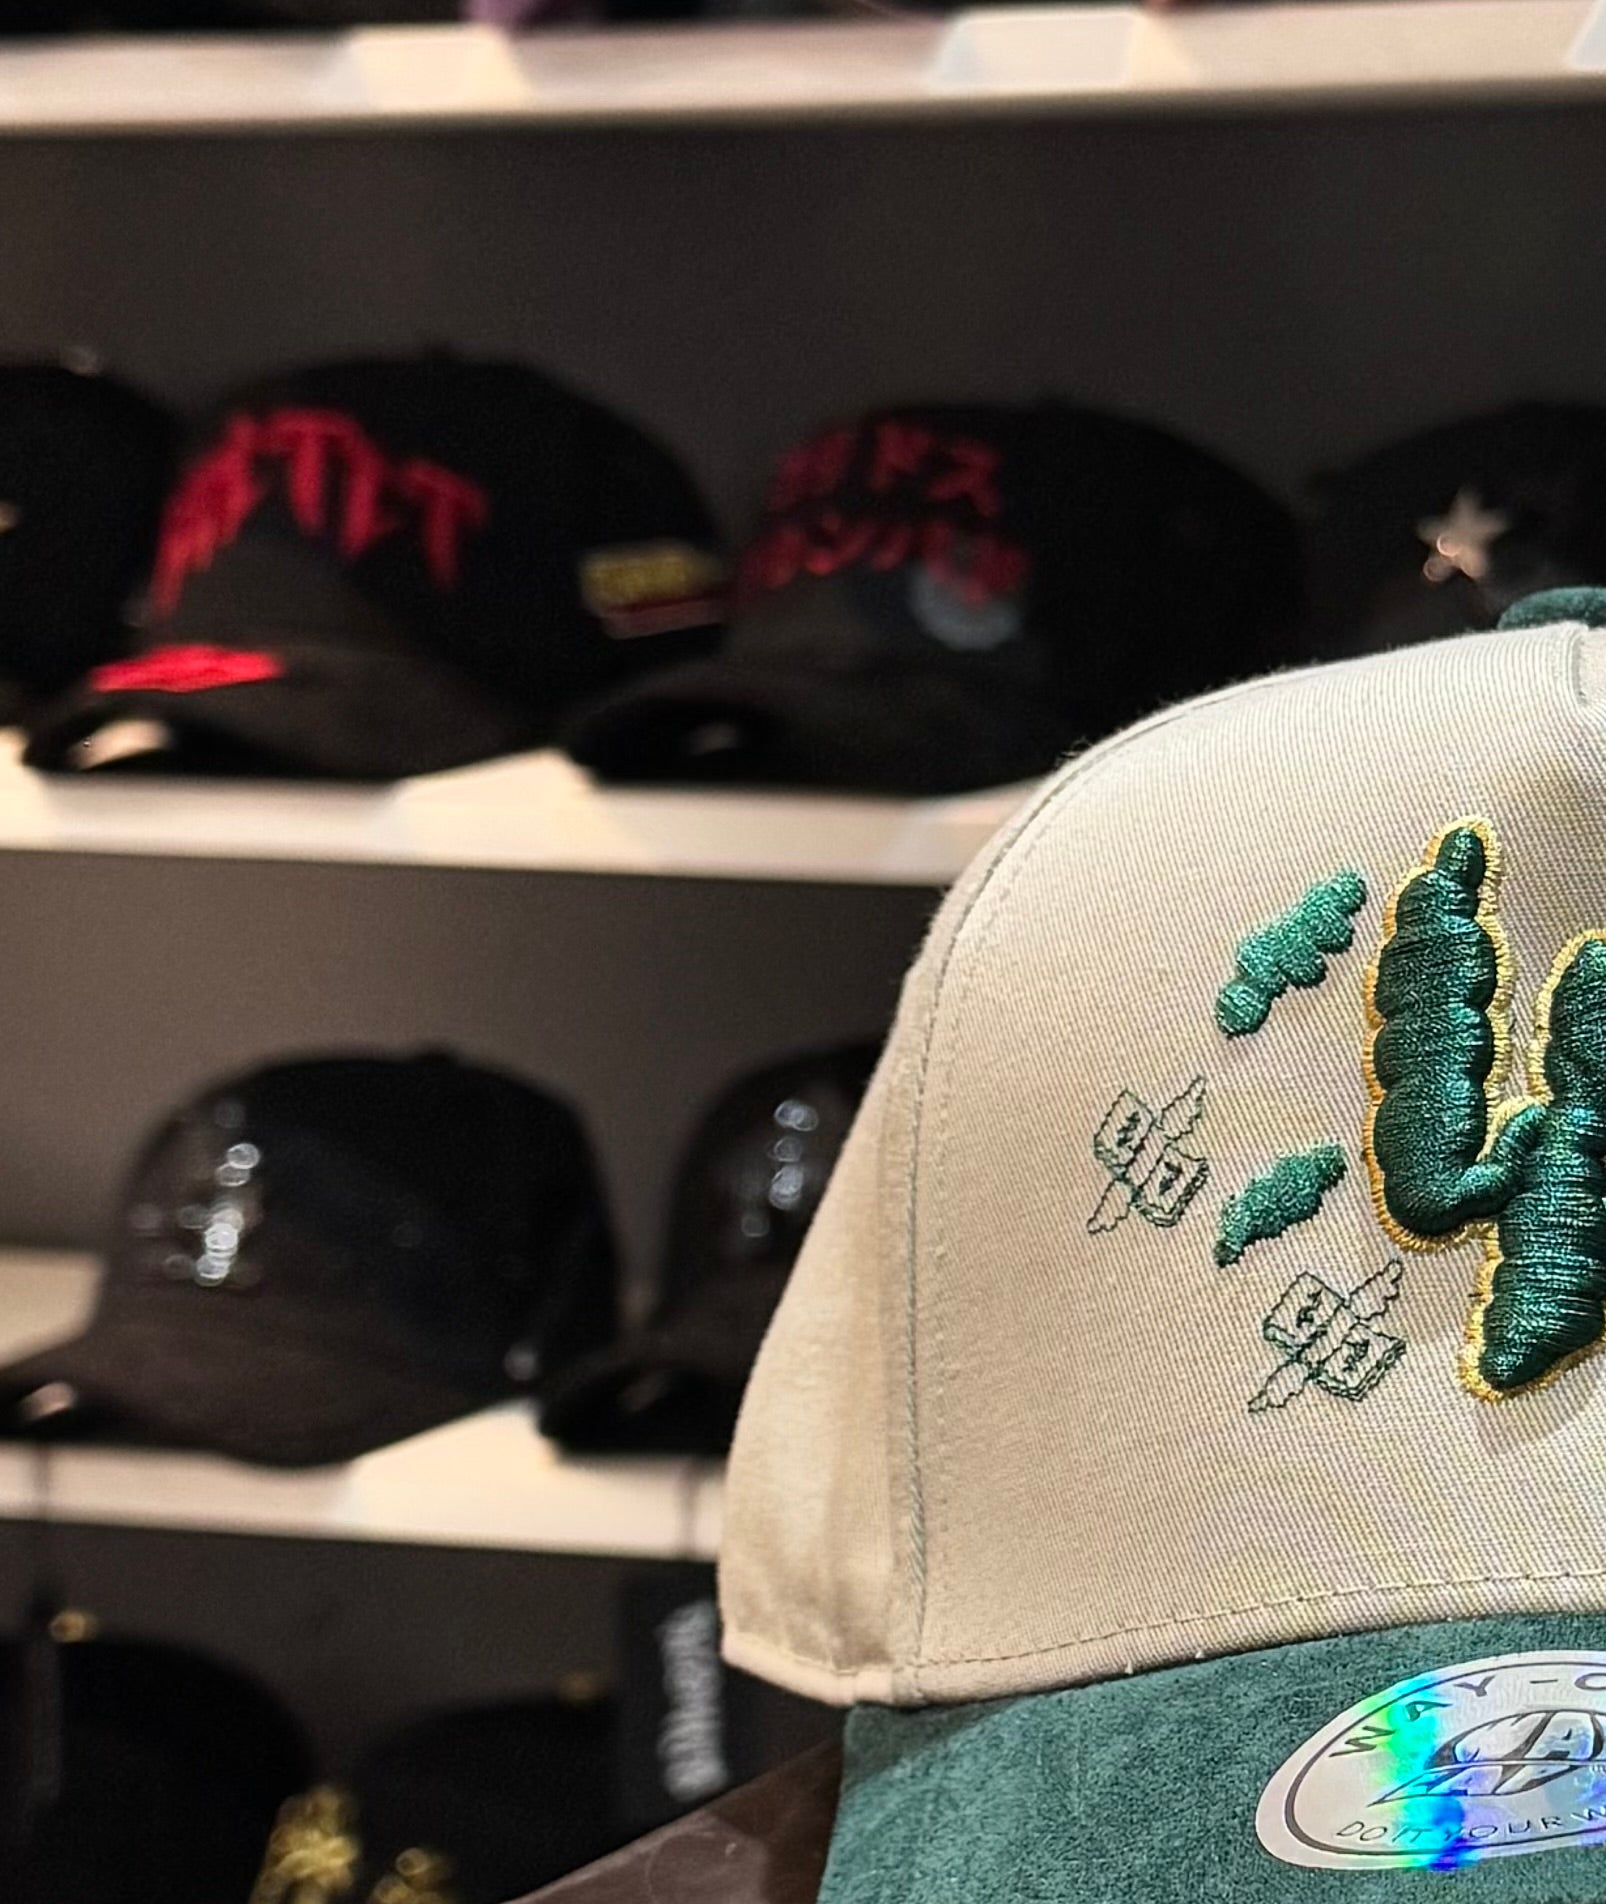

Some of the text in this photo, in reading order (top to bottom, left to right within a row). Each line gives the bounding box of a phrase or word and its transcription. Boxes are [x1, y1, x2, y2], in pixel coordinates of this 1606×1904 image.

[1335, 1819, 1388, 1842] DO
[1391, 1824, 1434, 1843] IT
[1443, 1815, 1564, 1842] YOUR
